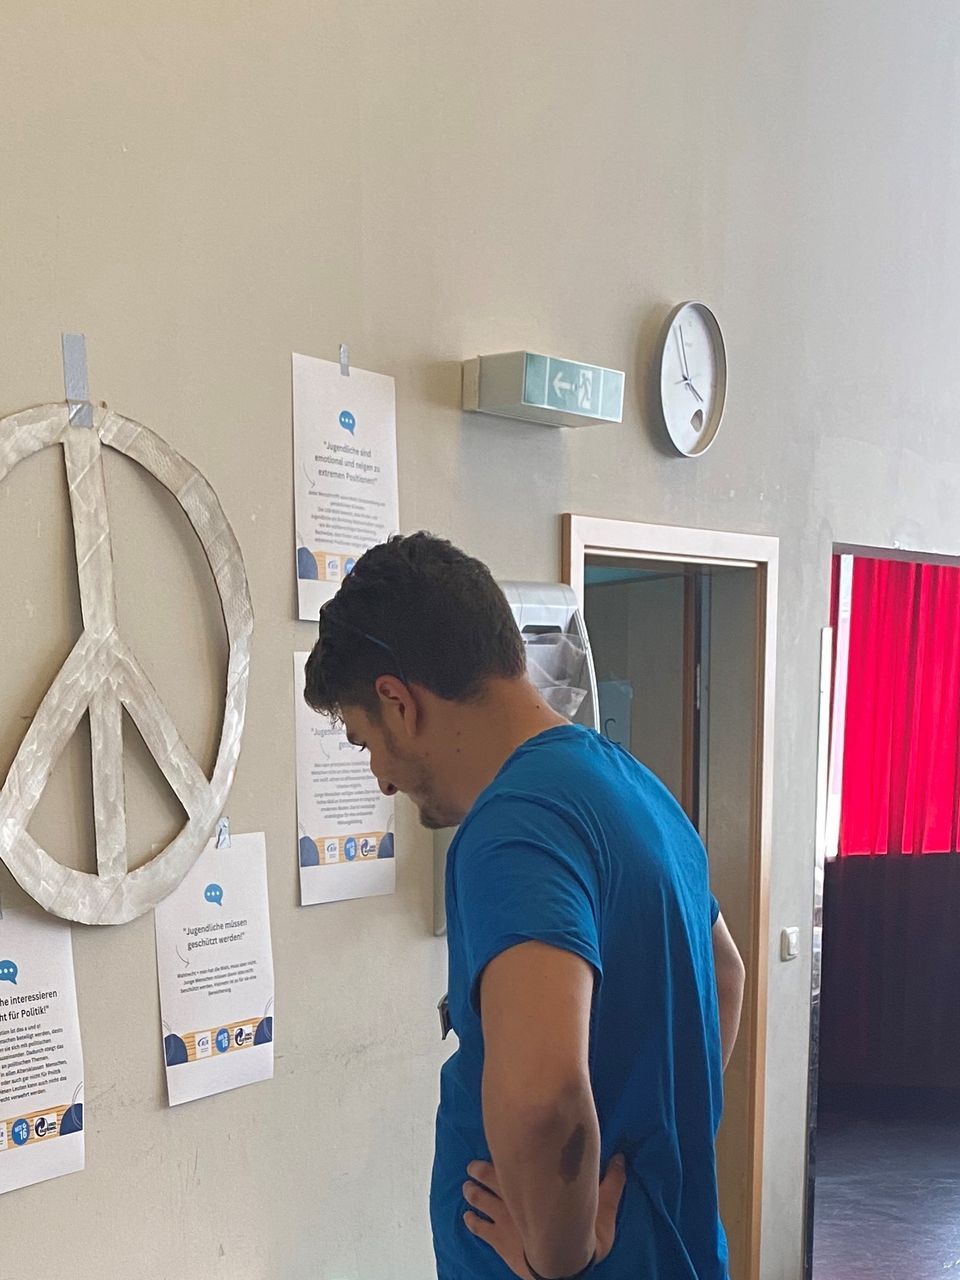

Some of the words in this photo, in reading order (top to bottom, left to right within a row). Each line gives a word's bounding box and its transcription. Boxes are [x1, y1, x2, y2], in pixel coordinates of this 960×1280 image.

[183, 923, 223, 936] "Jugendliche
[225, 919, 247, 929] müssen
[10, 990, 57, 1005] interessieren
[9, 1011, 19, 1020] für
[21, 1005, 49, 1017] Politik!"
[20, 1129, 27, 1140] 16
